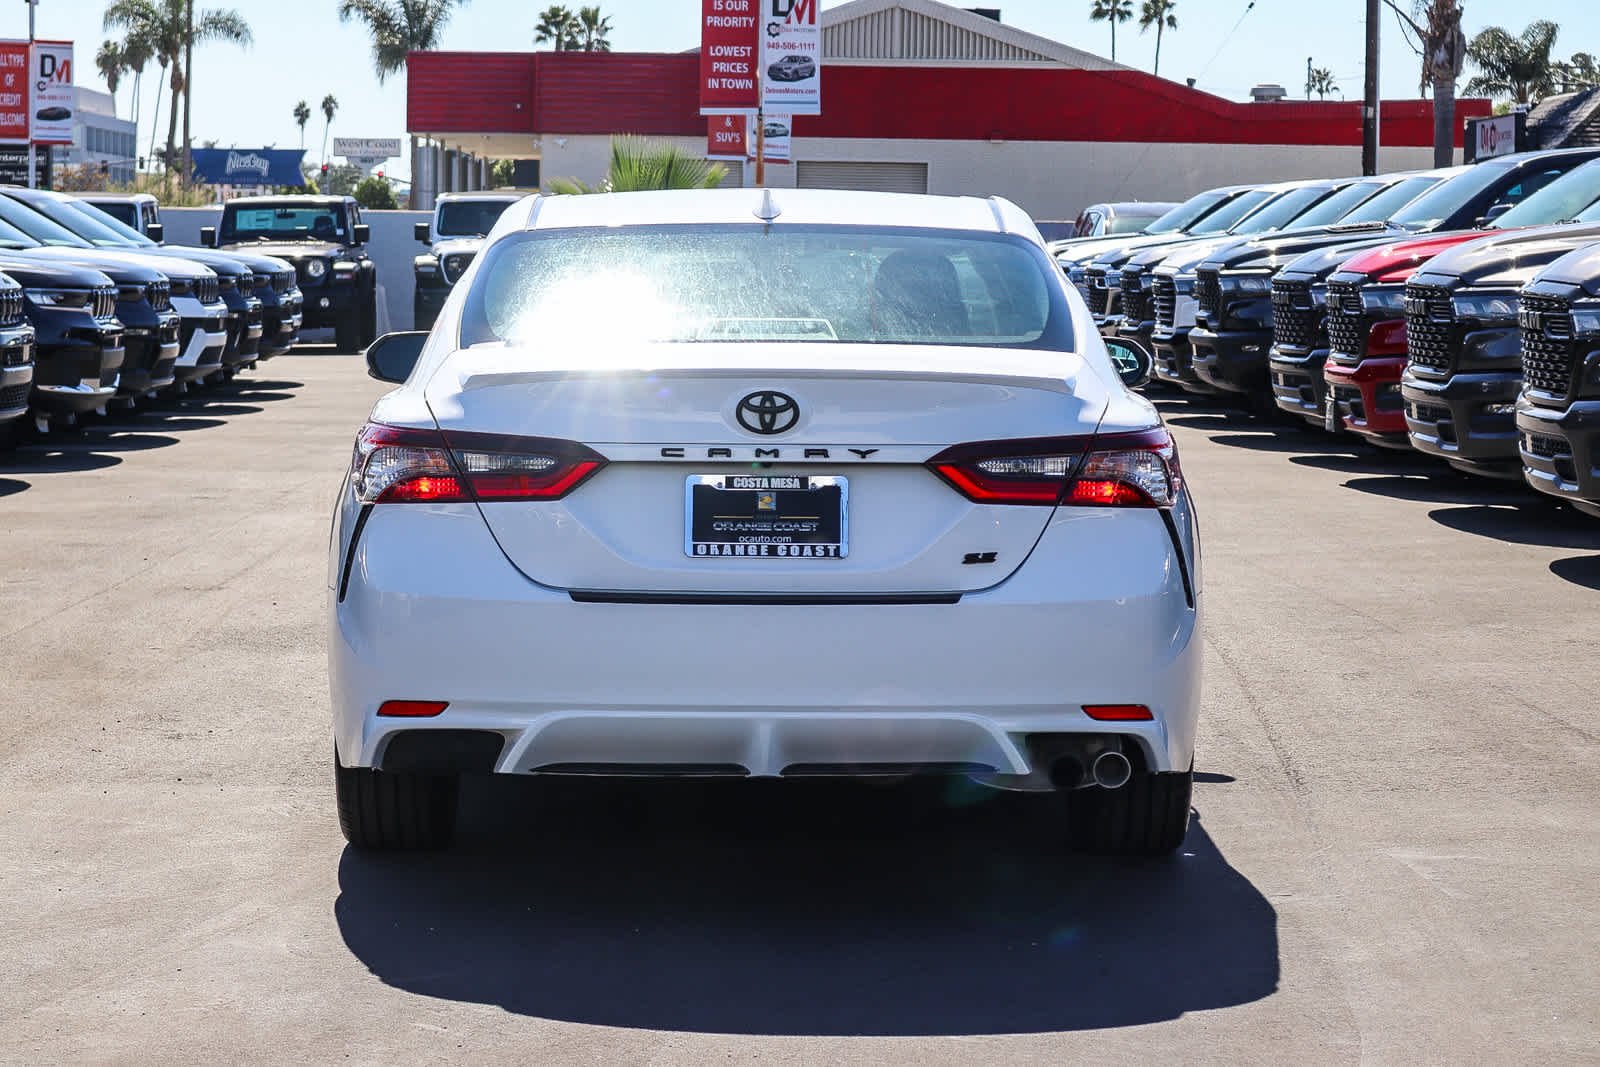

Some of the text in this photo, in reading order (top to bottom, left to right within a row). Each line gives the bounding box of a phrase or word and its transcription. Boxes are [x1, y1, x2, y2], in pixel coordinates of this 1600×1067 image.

[713, 0, 749, 11] IS OUR
[706, 16, 755, 28] PRIORITY
[709, 45, 752, 57] LOWEST
[9, 53, 25, 67] TYPE
[40, 54, 70, 83] DM
[712, 62, 749, 73] PRICES
[5, 73, 15, 87] OF
[708, 78, 753, 89] IN TOWN
[0, 112, 25, 126] ELCOME
[724, 116, 733, 128] &
[716, 131, 742, 143] SUV'S
[660, 447, 881, 459] CAMRY
[733, 477, 801, 489] COSTA MESA
[712, 521, 820, 532] ORANGE COAST
[738, 535, 792, 544] ocauto.com
[697, 544, 837, 557] ORANGE COAST
